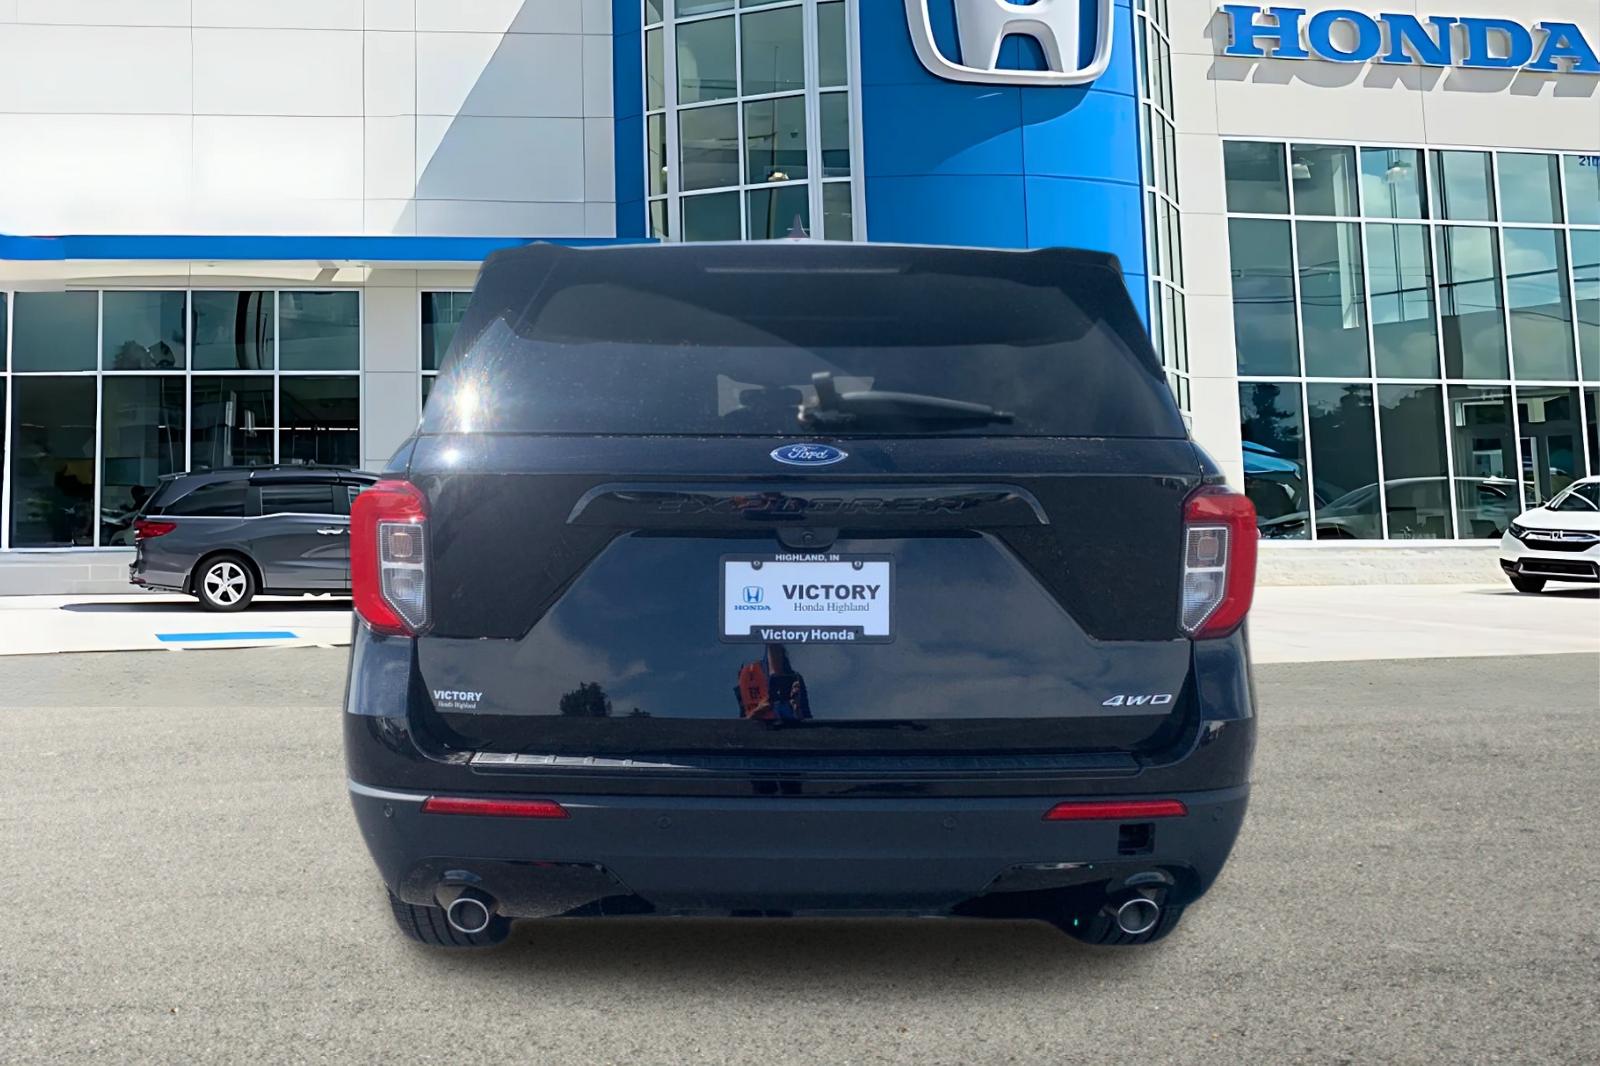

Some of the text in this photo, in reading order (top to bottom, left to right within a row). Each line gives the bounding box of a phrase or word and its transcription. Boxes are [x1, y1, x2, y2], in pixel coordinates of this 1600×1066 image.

[1219, 4, 1600, 73] HONDA
[787, 446, 829, 459] Ford
[775, 554, 828, 562] HIGHLAND,
[782, 584, 881, 600] VICTORY
[793, 602, 870, 614] Honda Highland
[761, 629, 855, 643] Victory Honda
[433, 690, 482, 701] VICTORY
[1102, 694, 1172, 706] 4WD
